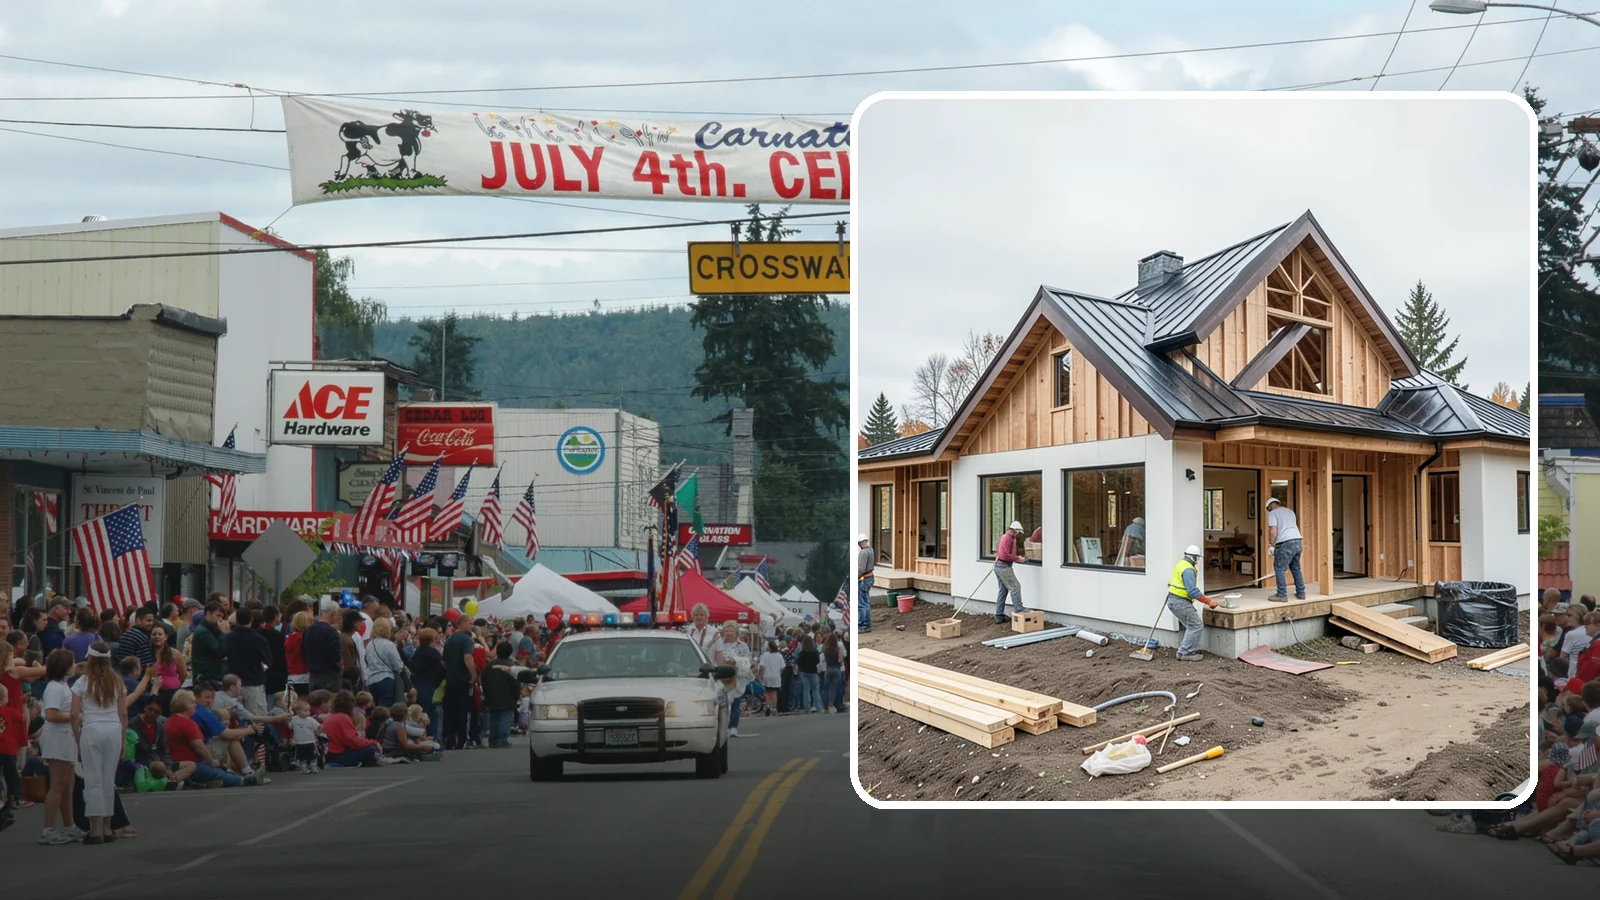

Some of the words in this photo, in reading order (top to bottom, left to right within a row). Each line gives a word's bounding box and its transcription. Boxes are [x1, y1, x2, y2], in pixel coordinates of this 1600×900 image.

[695, 122, 850, 149] Carnat
[481, 141, 605, 192] JULY
[632, 149, 746, 198] 4th.
[697, 254, 850, 280] CROSSWA
[283, 380, 374, 420] ACE
[405, 409, 452, 421] CEDAR
[461, 409, 485, 421] LOG
[283, 421, 371, 436] Hardware
[416, 428, 477, 446] Coca-Cola
[353, 467, 384, 480] Simpl
[83, 485, 94, 494] St.
[96, 485, 124, 495] Vincent
[126, 486, 136, 495] de
[137, 486, 155, 495] Paul
[688, 526, 741, 535] CRNATION
[699, 535, 730, 543] GLASS
